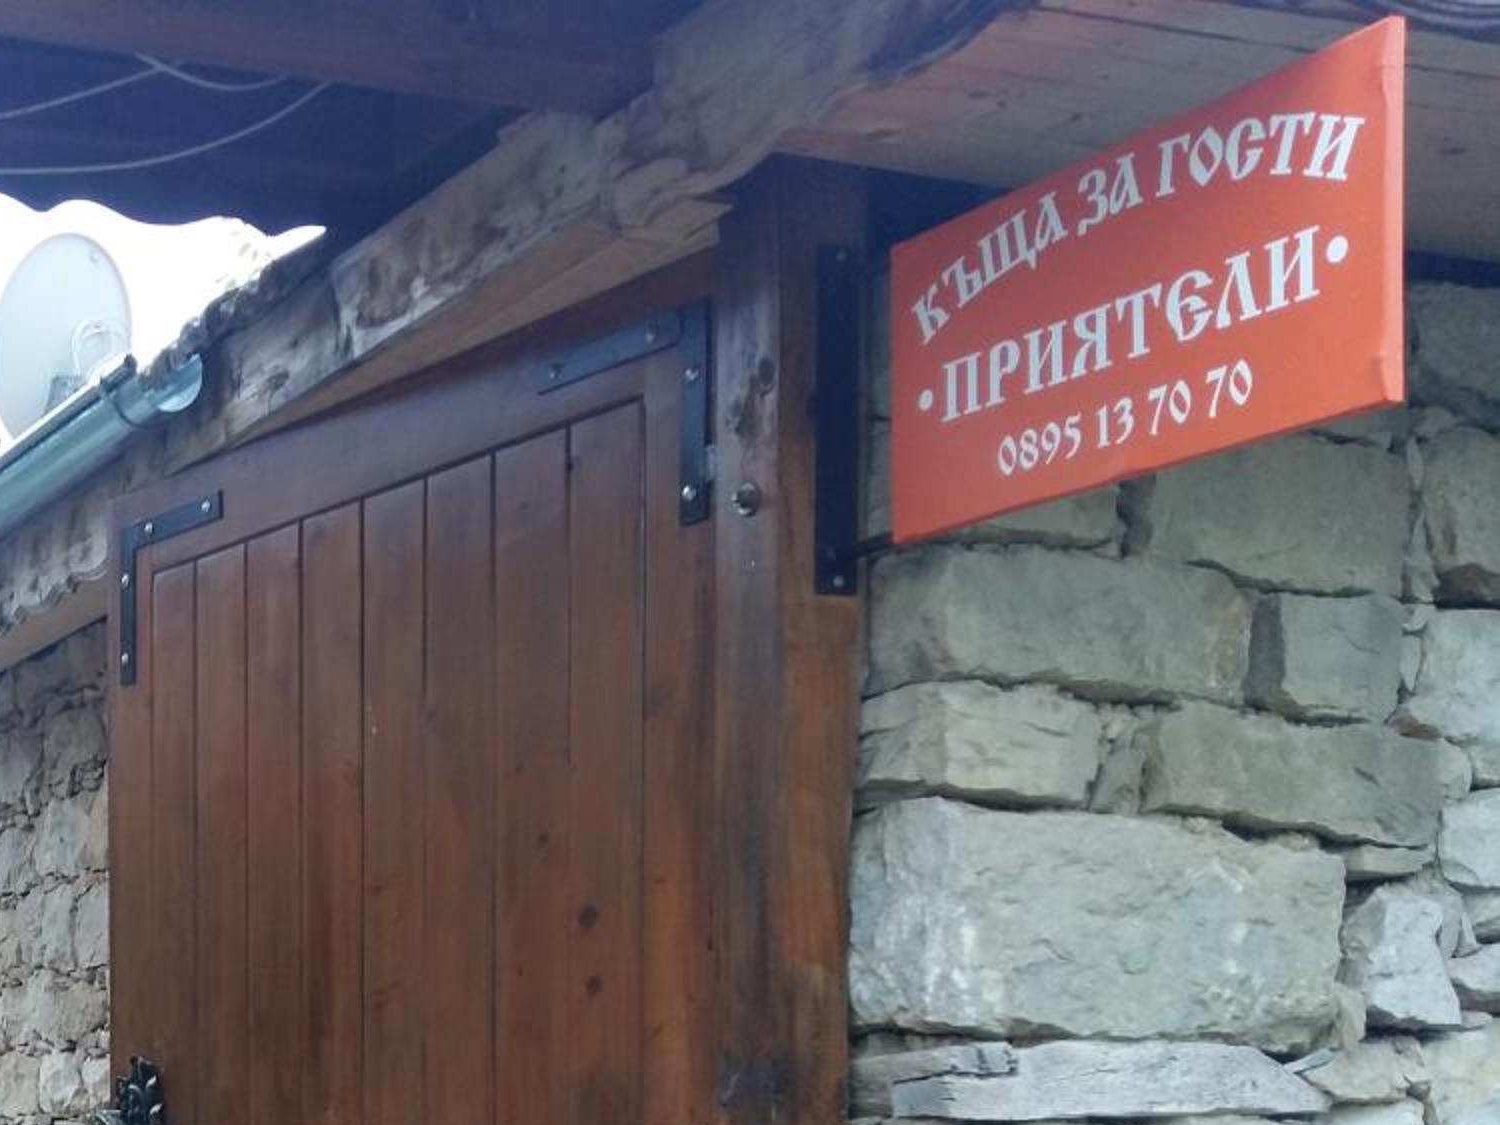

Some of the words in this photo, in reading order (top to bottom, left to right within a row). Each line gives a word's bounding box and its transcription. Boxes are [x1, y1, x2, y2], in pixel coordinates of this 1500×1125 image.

[910, 192, 1069, 344] КЪЩА
[1078, 153, 1144, 237] ЗА
[1155, 111, 1366, 199] ГОСТИ
[997, 415, 1082, 476] 0895
[1095, 397, 1135, 449] 13
[1149, 380, 1191, 436] 70
[1206, 359, 1253, 419] 70
